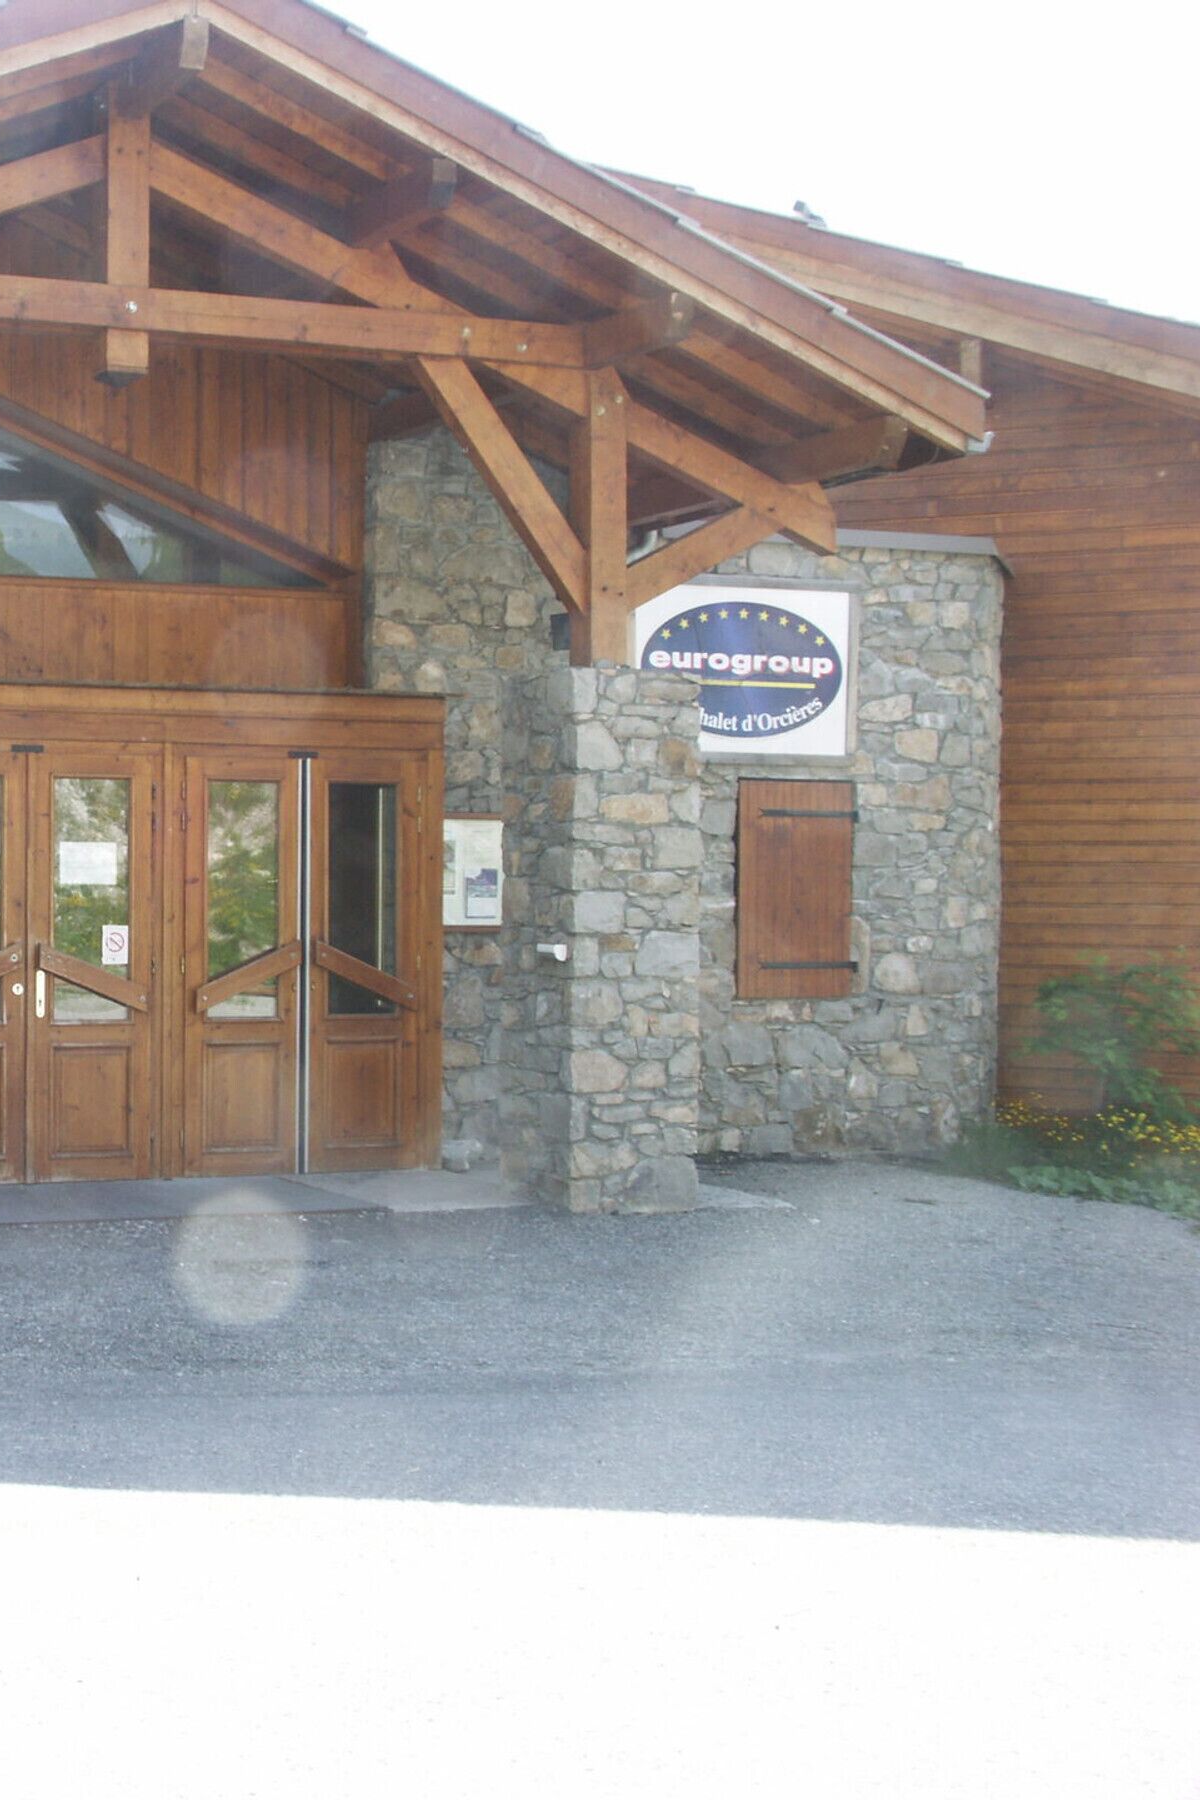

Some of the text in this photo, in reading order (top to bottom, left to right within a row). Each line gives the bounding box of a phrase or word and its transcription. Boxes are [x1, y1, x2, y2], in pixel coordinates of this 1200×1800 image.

[649, 650, 834, 678] eurogroup
[700, 697, 823, 732] halet d'Orcières
